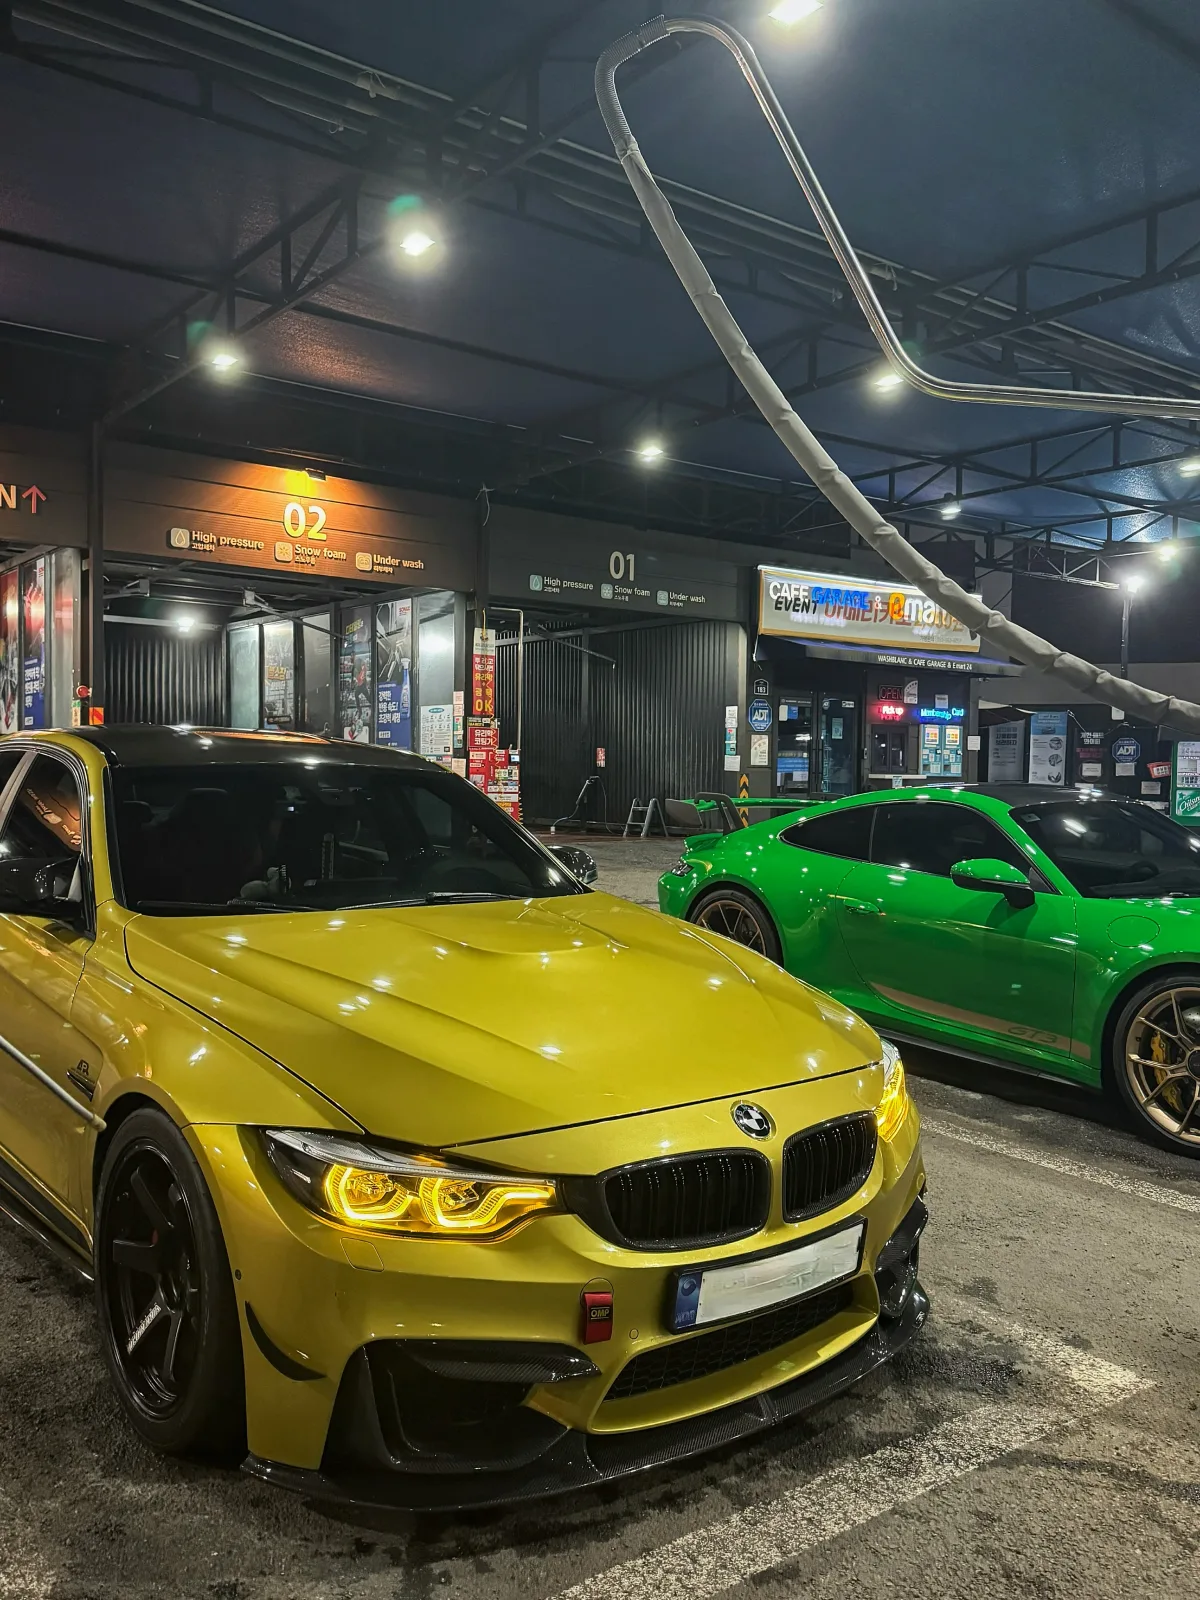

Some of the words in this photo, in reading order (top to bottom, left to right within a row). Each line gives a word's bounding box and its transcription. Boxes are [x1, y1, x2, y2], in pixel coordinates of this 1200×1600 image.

[283, 502, 327, 541] 02
[192, 531, 217, 544] High
[219, 536, 265, 549] pressure
[295, 544, 321, 557] Snow
[323, 548, 347, 560] foam
[373, 554, 399, 566] Under
[402, 559, 424, 569] wash
[609, 551, 635, 582] 01
[544, 576, 561, 587] High
[563, 580, 594, 591] pressure
[614, 585, 633, 595] Snow
[634, 587, 650, 597] foam
[669, 592, 689, 602] Under
[690, 595, 706, 604] wash
[769, 581, 810, 602] CAFE
[811, 586, 870, 610] GARAGE
[774, 596, 819, 615] EVENT
[877, 655, 908, 665] WASHBLANC
[913, 658, 926, 667] CAFE
[926, 660, 947, 668] GARAGE
[880, 687, 903, 700] OPEN
[475, 699, 493, 712] OK
[951, 707, 964, 716] Card
[752, 709, 769, 721] ADT
[1116, 745, 1137, 756] ADT
[1008, 1026, 1058, 1043] GT3
[590, 1308, 610, 1318] OMP
